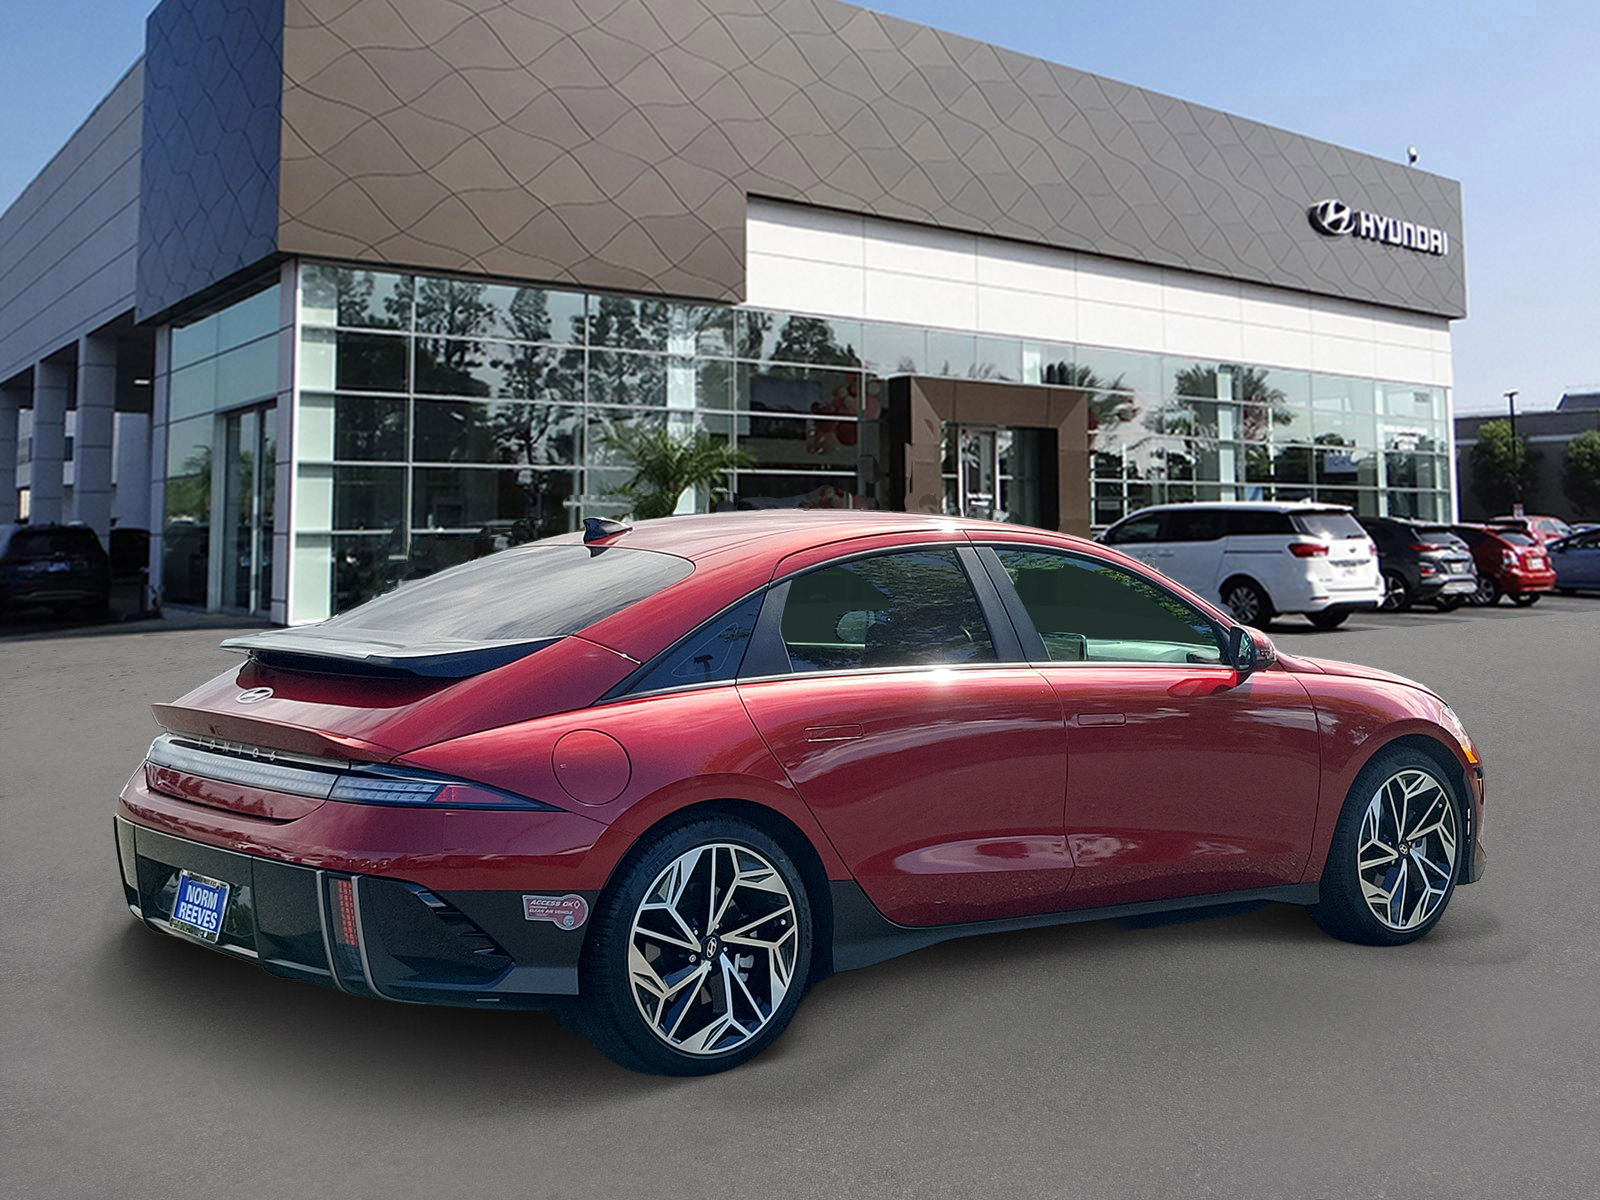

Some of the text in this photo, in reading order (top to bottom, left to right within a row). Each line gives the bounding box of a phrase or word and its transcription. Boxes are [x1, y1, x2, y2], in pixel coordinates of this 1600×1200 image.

[1360, 211, 1448, 255] HYUNDAI
[185, 884, 219, 910] NORM
[178, 901, 218, 930] REEVES
